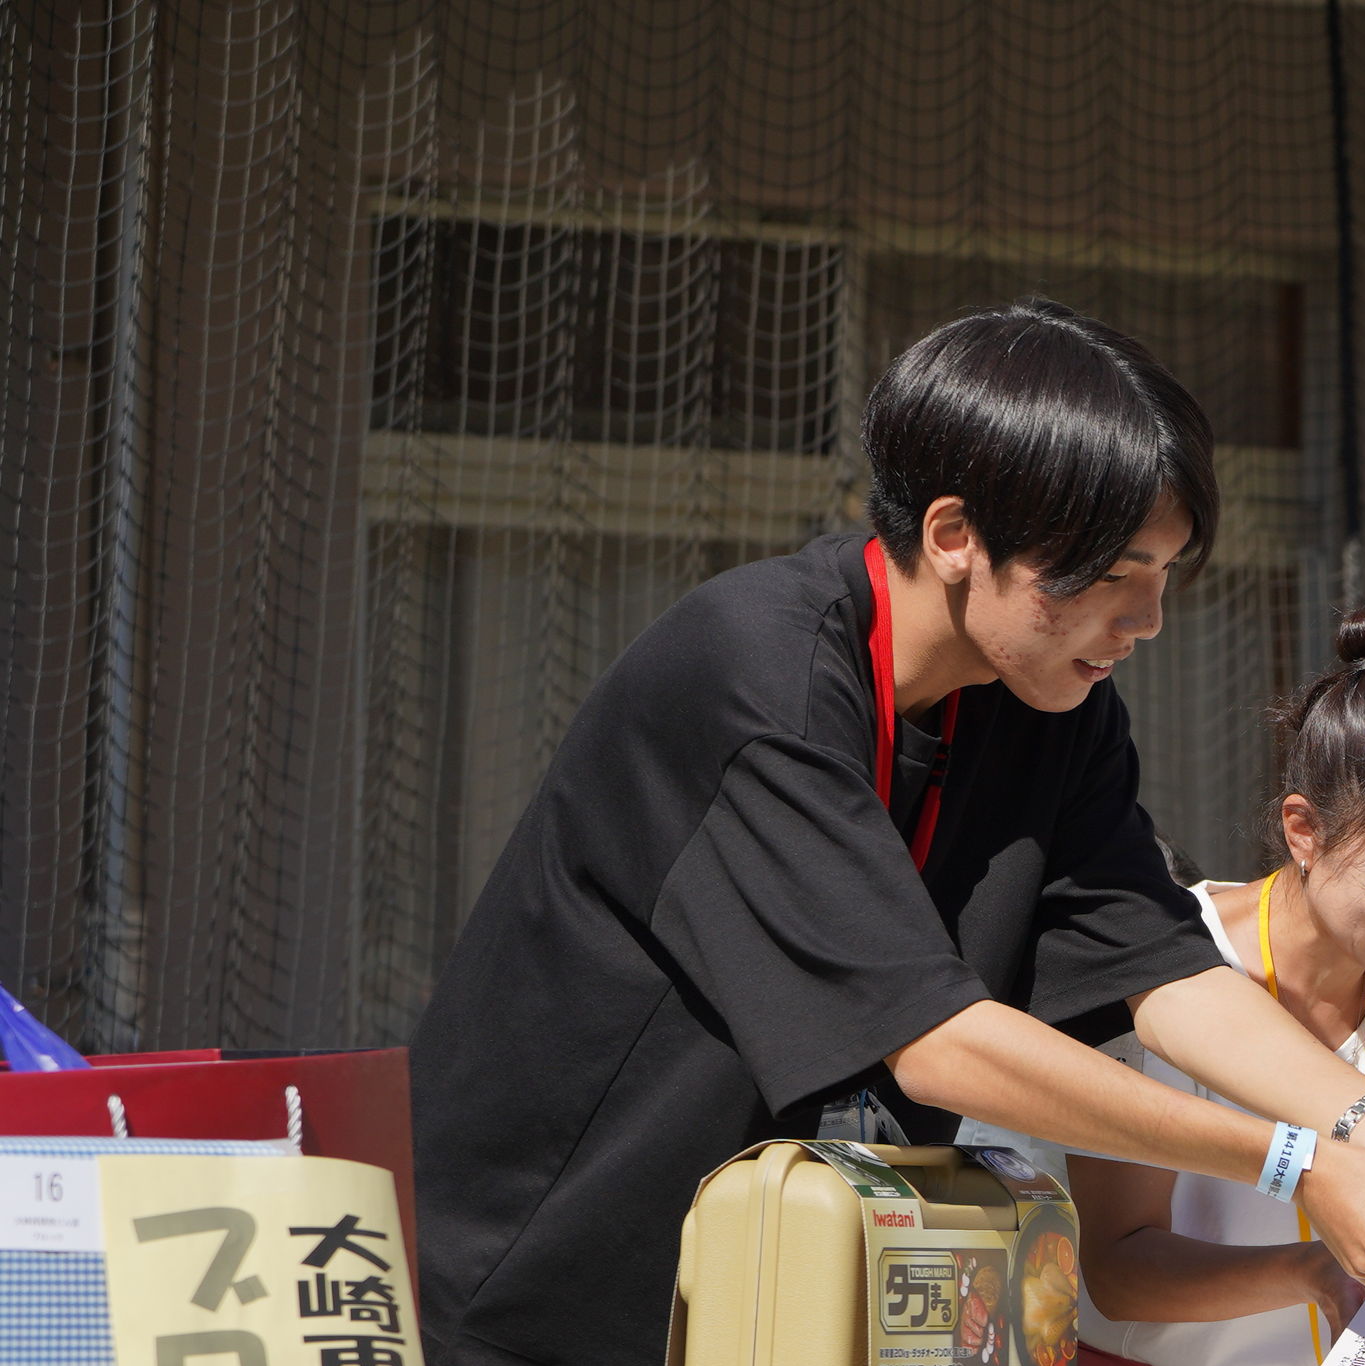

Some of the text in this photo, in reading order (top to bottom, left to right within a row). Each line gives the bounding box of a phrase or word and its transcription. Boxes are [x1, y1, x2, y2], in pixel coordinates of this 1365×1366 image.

[33, 1171, 65, 1202] 16
[872, 1209, 915, 1228] Iwatani
[910, 1267, 933, 1278] TOUGH
